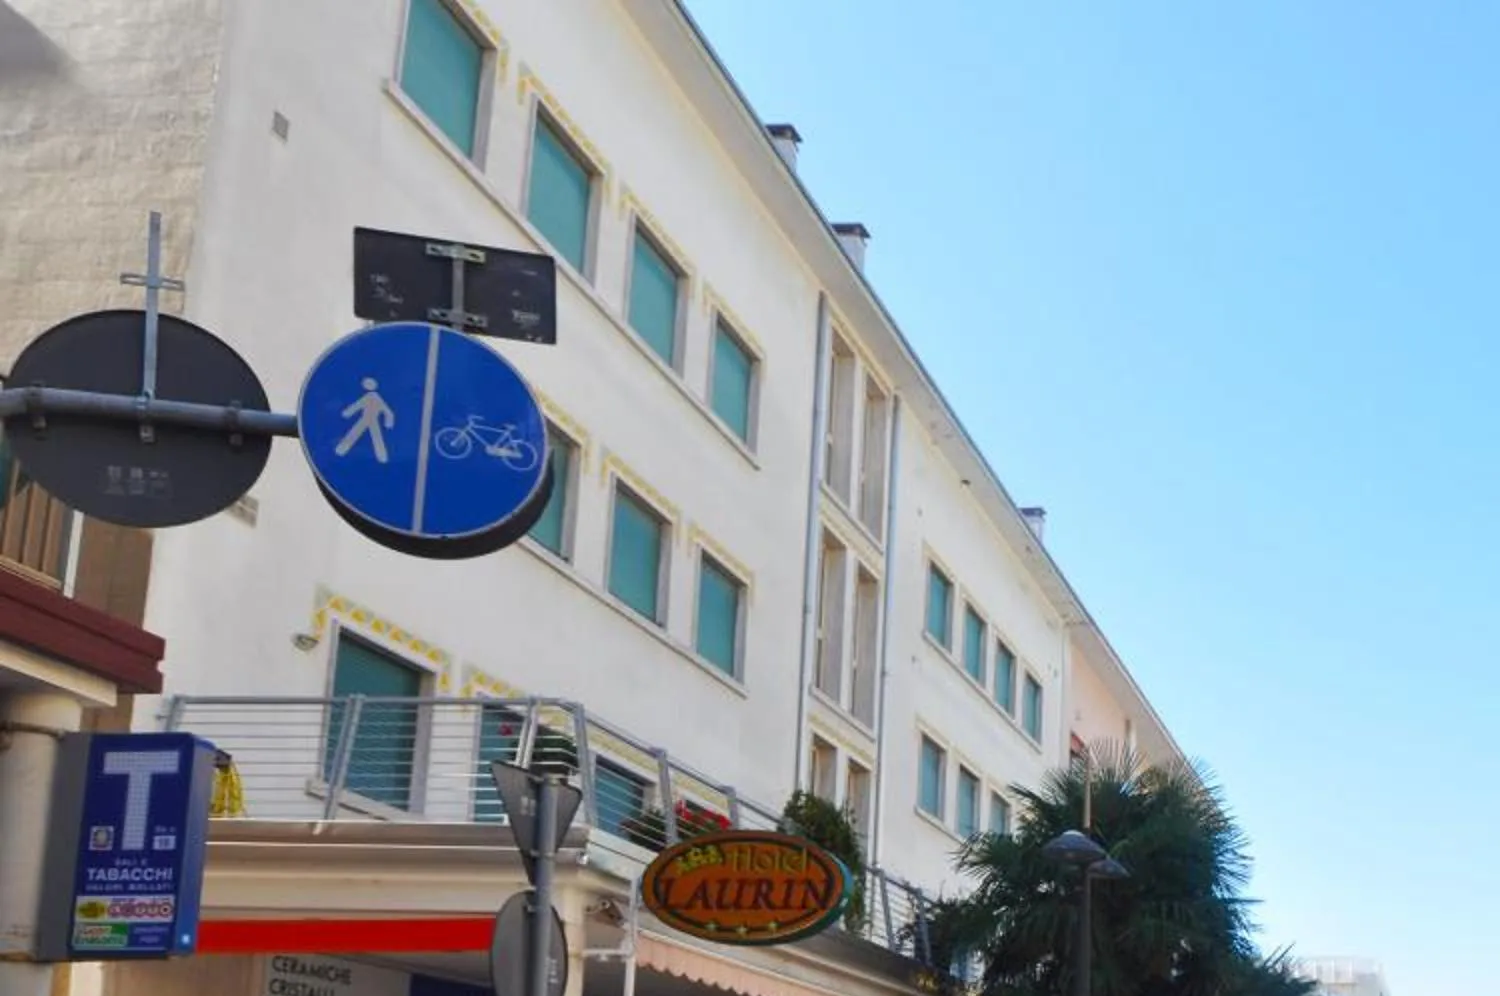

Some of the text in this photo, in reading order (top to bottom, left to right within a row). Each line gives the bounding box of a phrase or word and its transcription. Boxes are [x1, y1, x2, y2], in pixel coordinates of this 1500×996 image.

[103, 750, 180, 851] T
[87, 867, 174, 882] TABACCHI
[731, 847, 808, 872] Hotel
[657, 877, 832, 911] LAURIN
[271, 955, 352, 986] CERAMICHE
